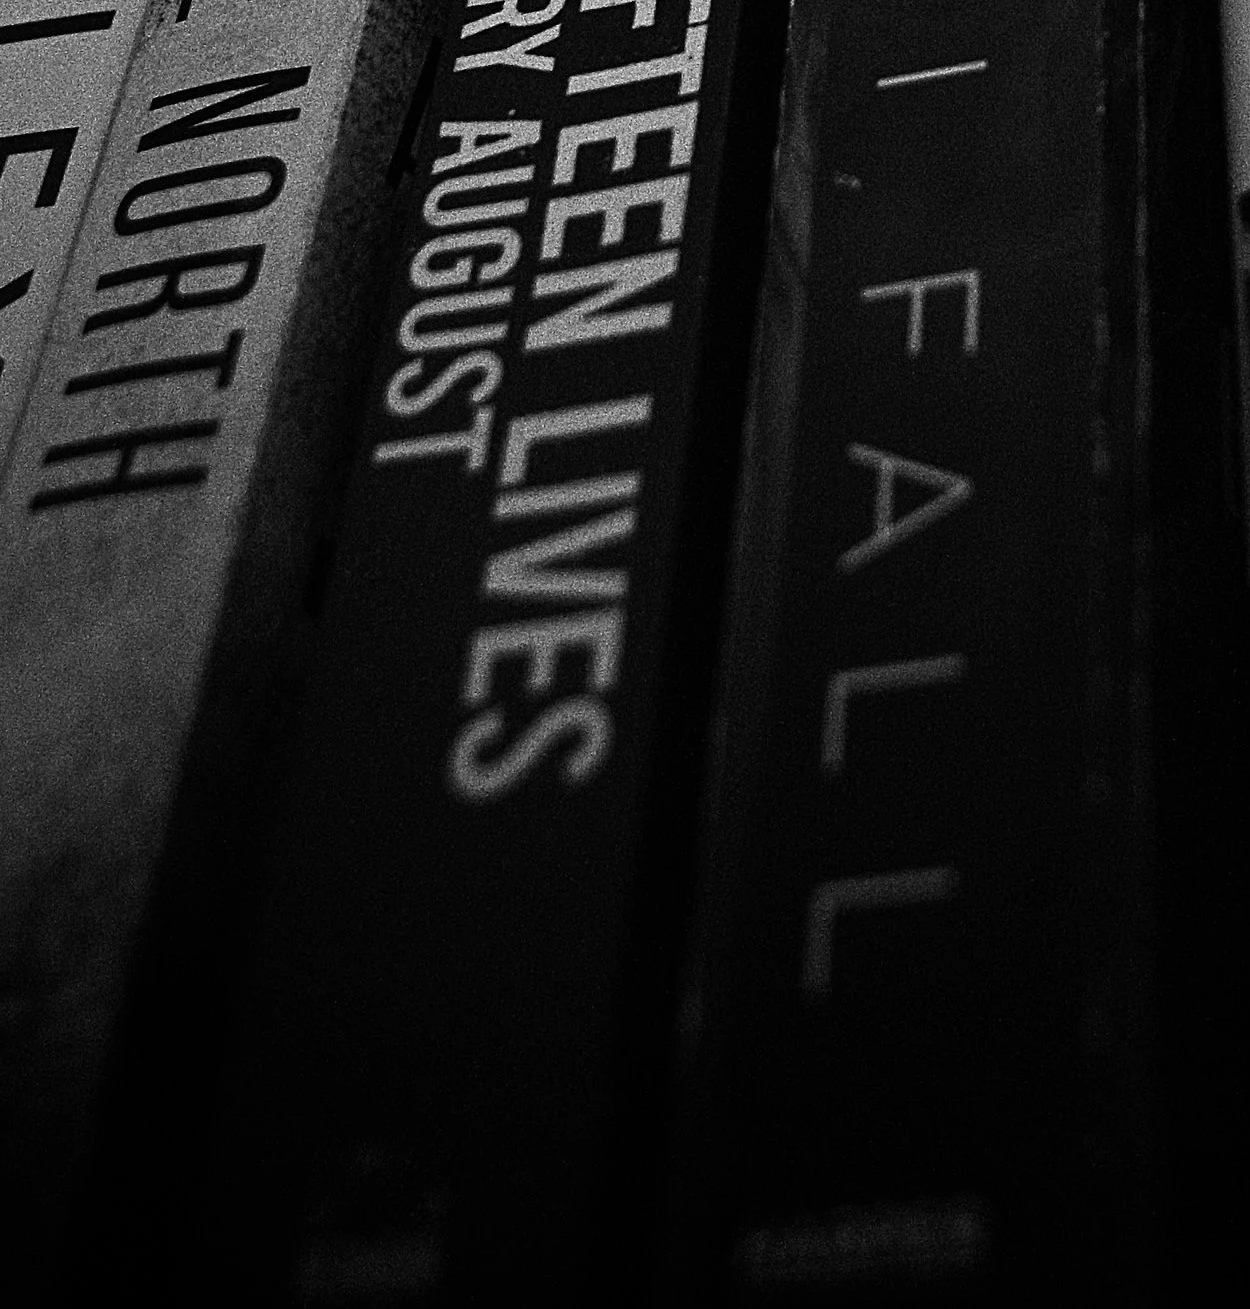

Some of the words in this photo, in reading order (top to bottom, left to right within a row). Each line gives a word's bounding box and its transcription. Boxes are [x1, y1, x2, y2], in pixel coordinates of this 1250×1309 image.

[876, 58, 989, 89] I
[29, 65, 312, 513] NORTH
[372, 117, 543, 474] AUGUST
[446, 392, 655, 802] LIVES
[803, 267, 982, 995] FALL
